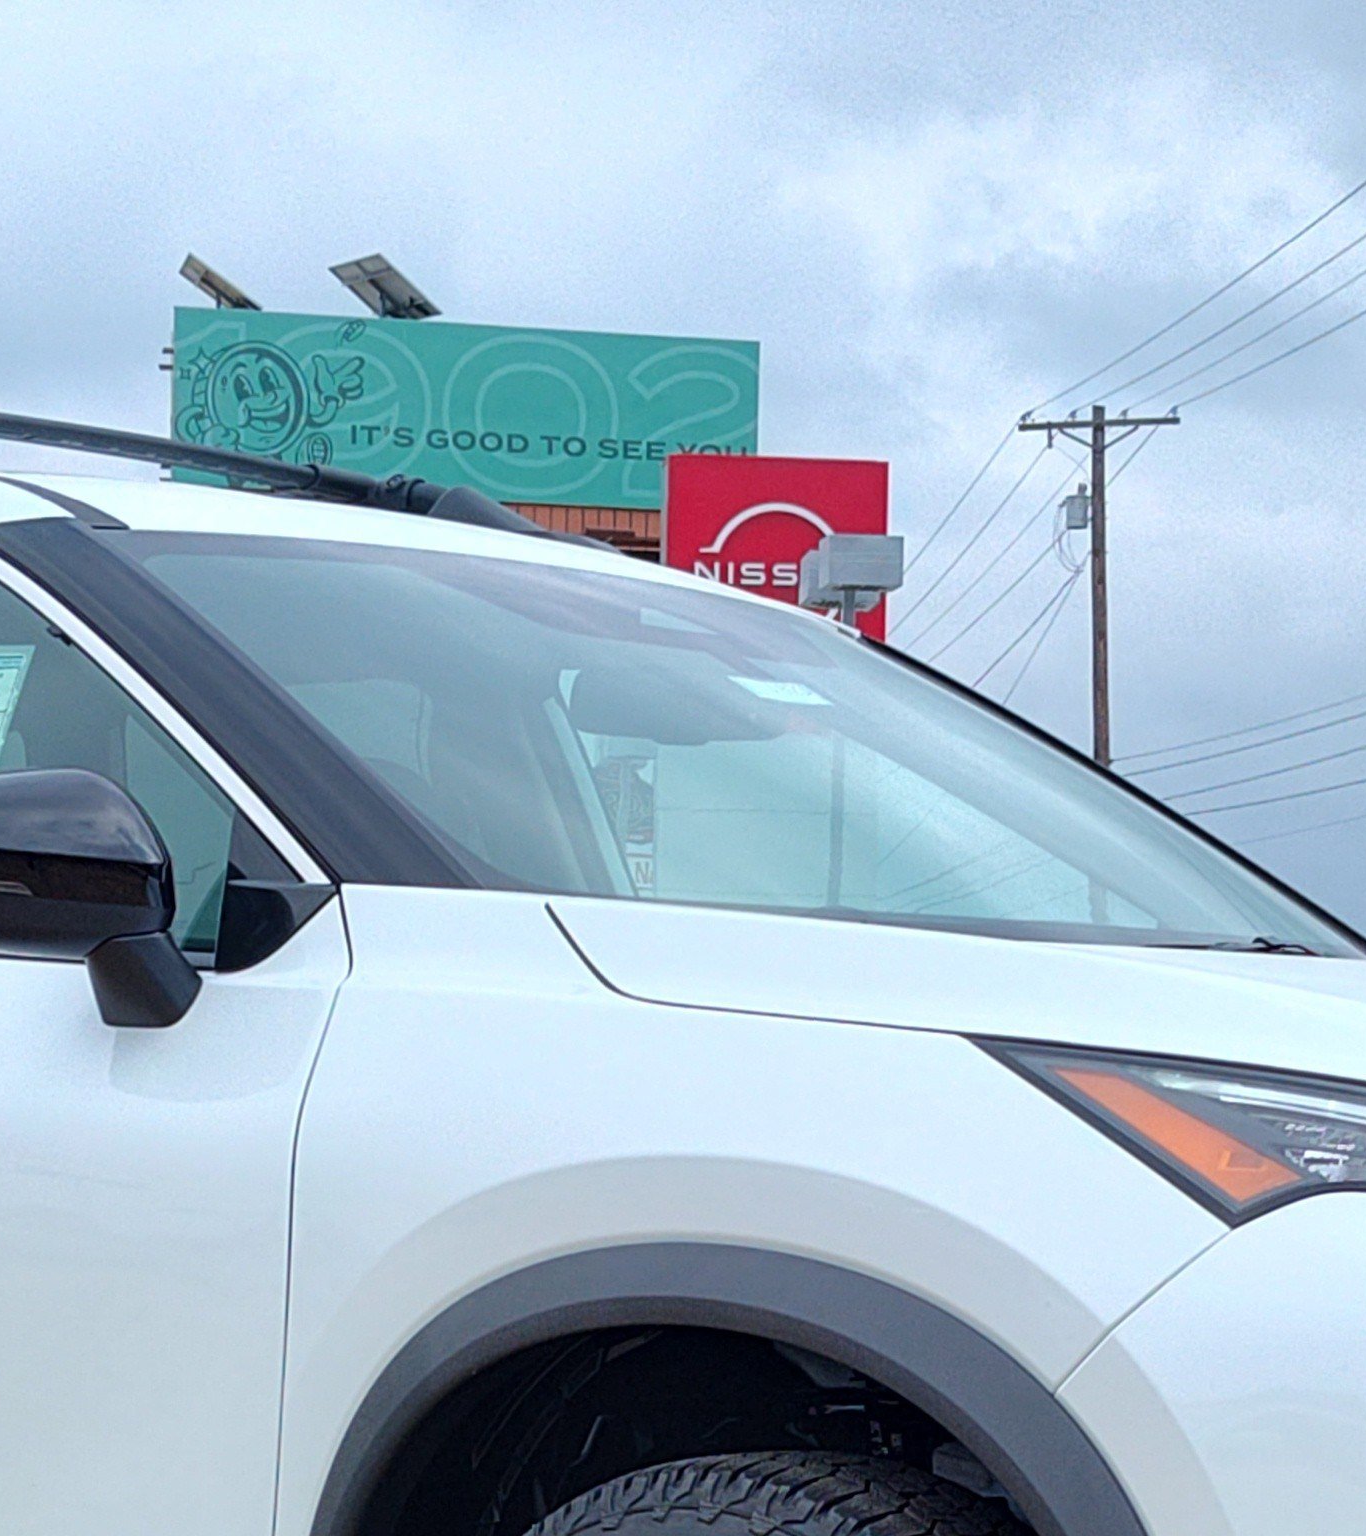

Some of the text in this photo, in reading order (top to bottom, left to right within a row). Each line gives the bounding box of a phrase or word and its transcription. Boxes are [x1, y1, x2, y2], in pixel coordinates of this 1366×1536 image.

[350, 424, 415, 447] IT'S
[426, 428, 529, 453] GOOD
[540, 435, 587, 457] TO
[597, 438, 666, 461] SEE
[693, 560, 798, 587] NISS
